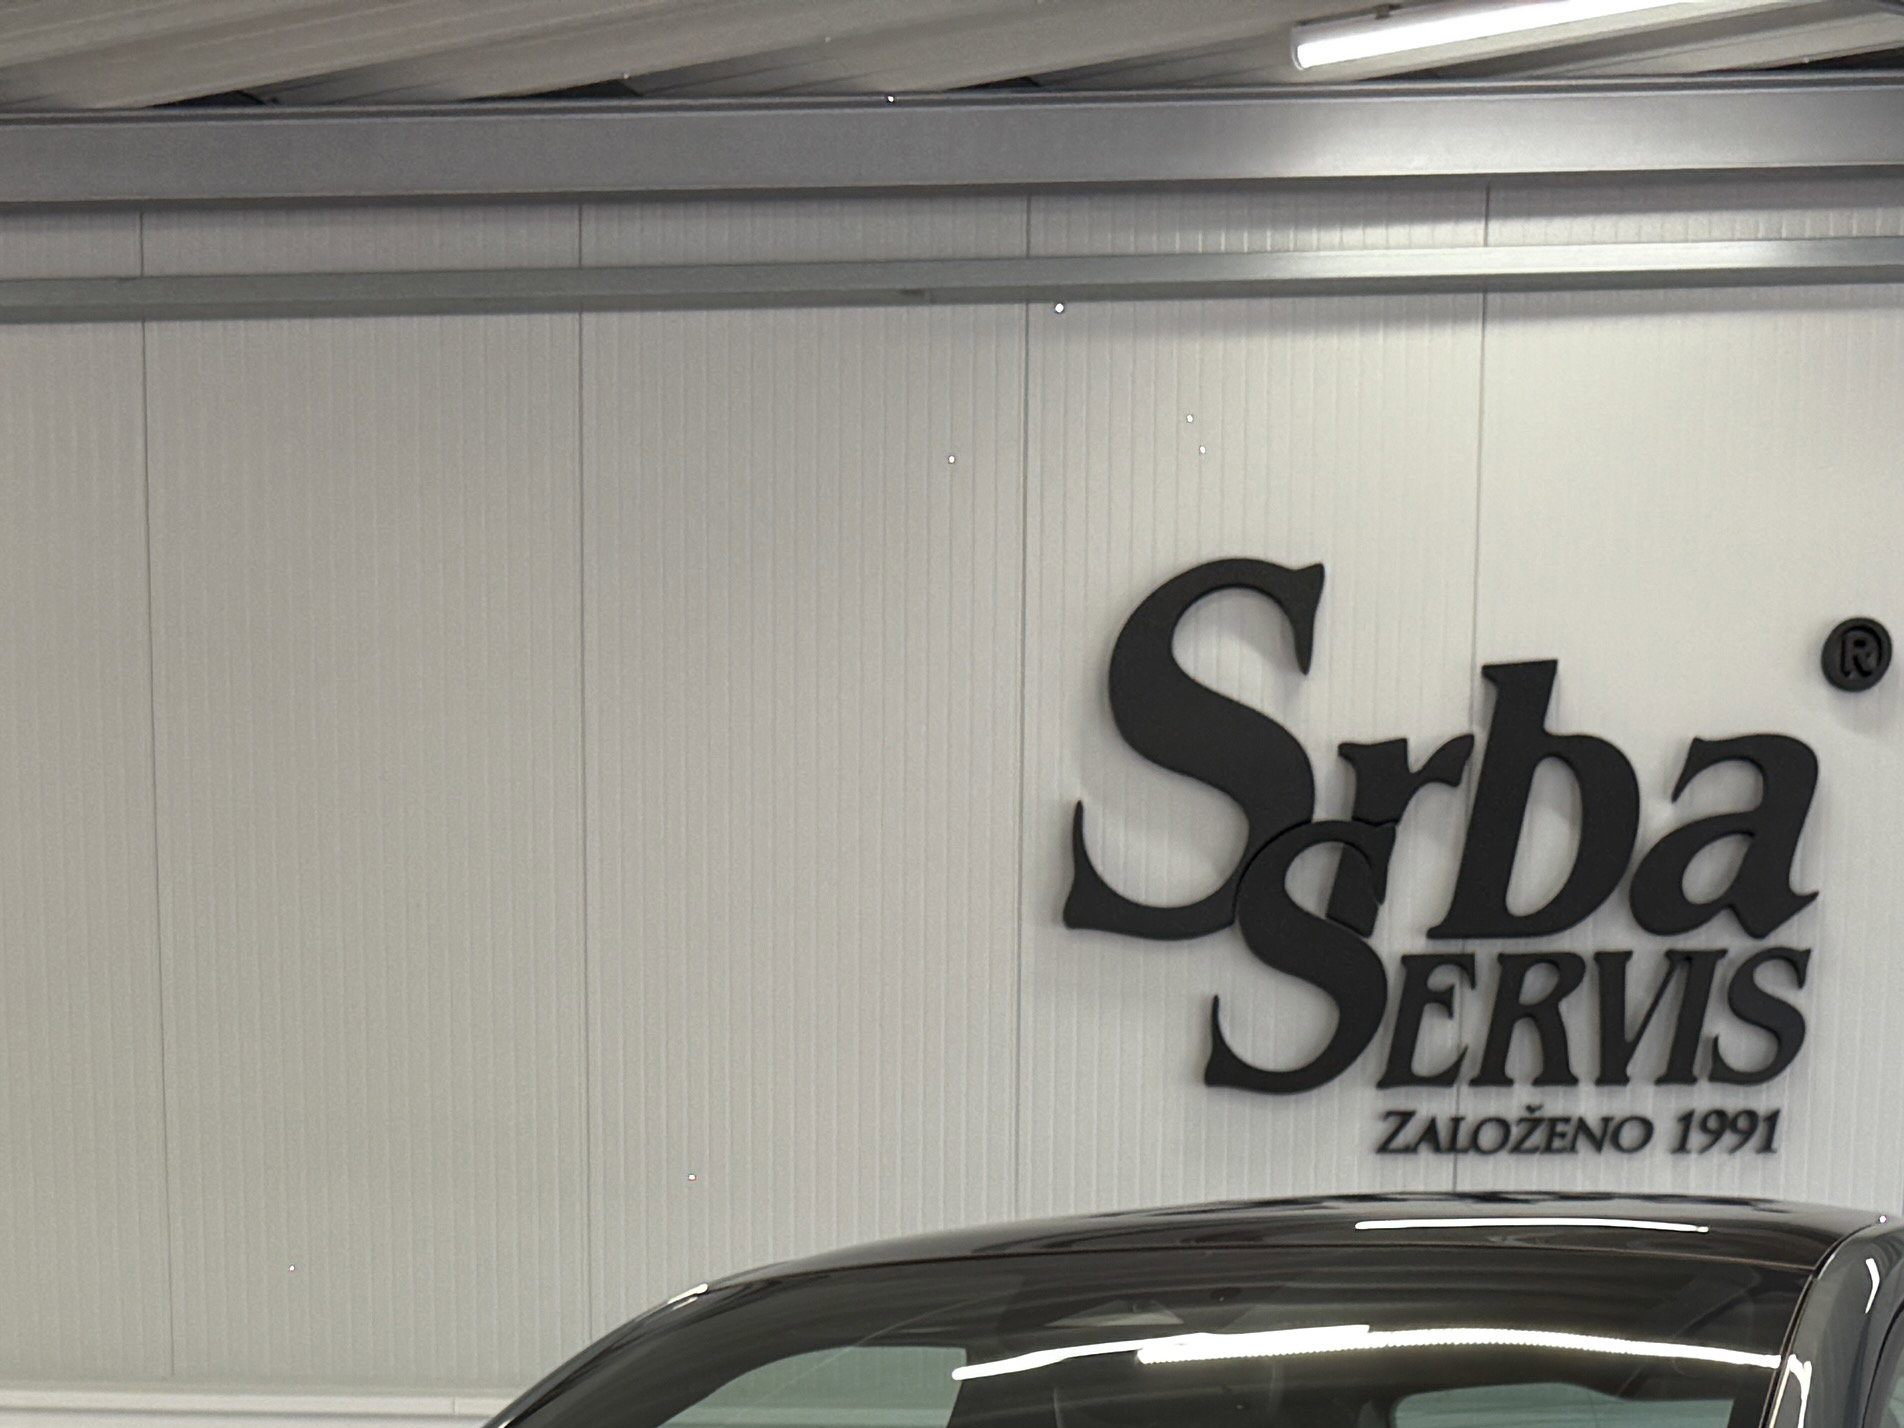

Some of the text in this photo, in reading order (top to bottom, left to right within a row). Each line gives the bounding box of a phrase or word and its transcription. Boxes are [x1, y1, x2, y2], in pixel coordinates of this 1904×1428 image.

[1063, 557, 1820, 941] Srba
[1204, 819, 1812, 1095] SERVIS
[1375, 1104, 1783, 1155] ZALOŽENO 1991
